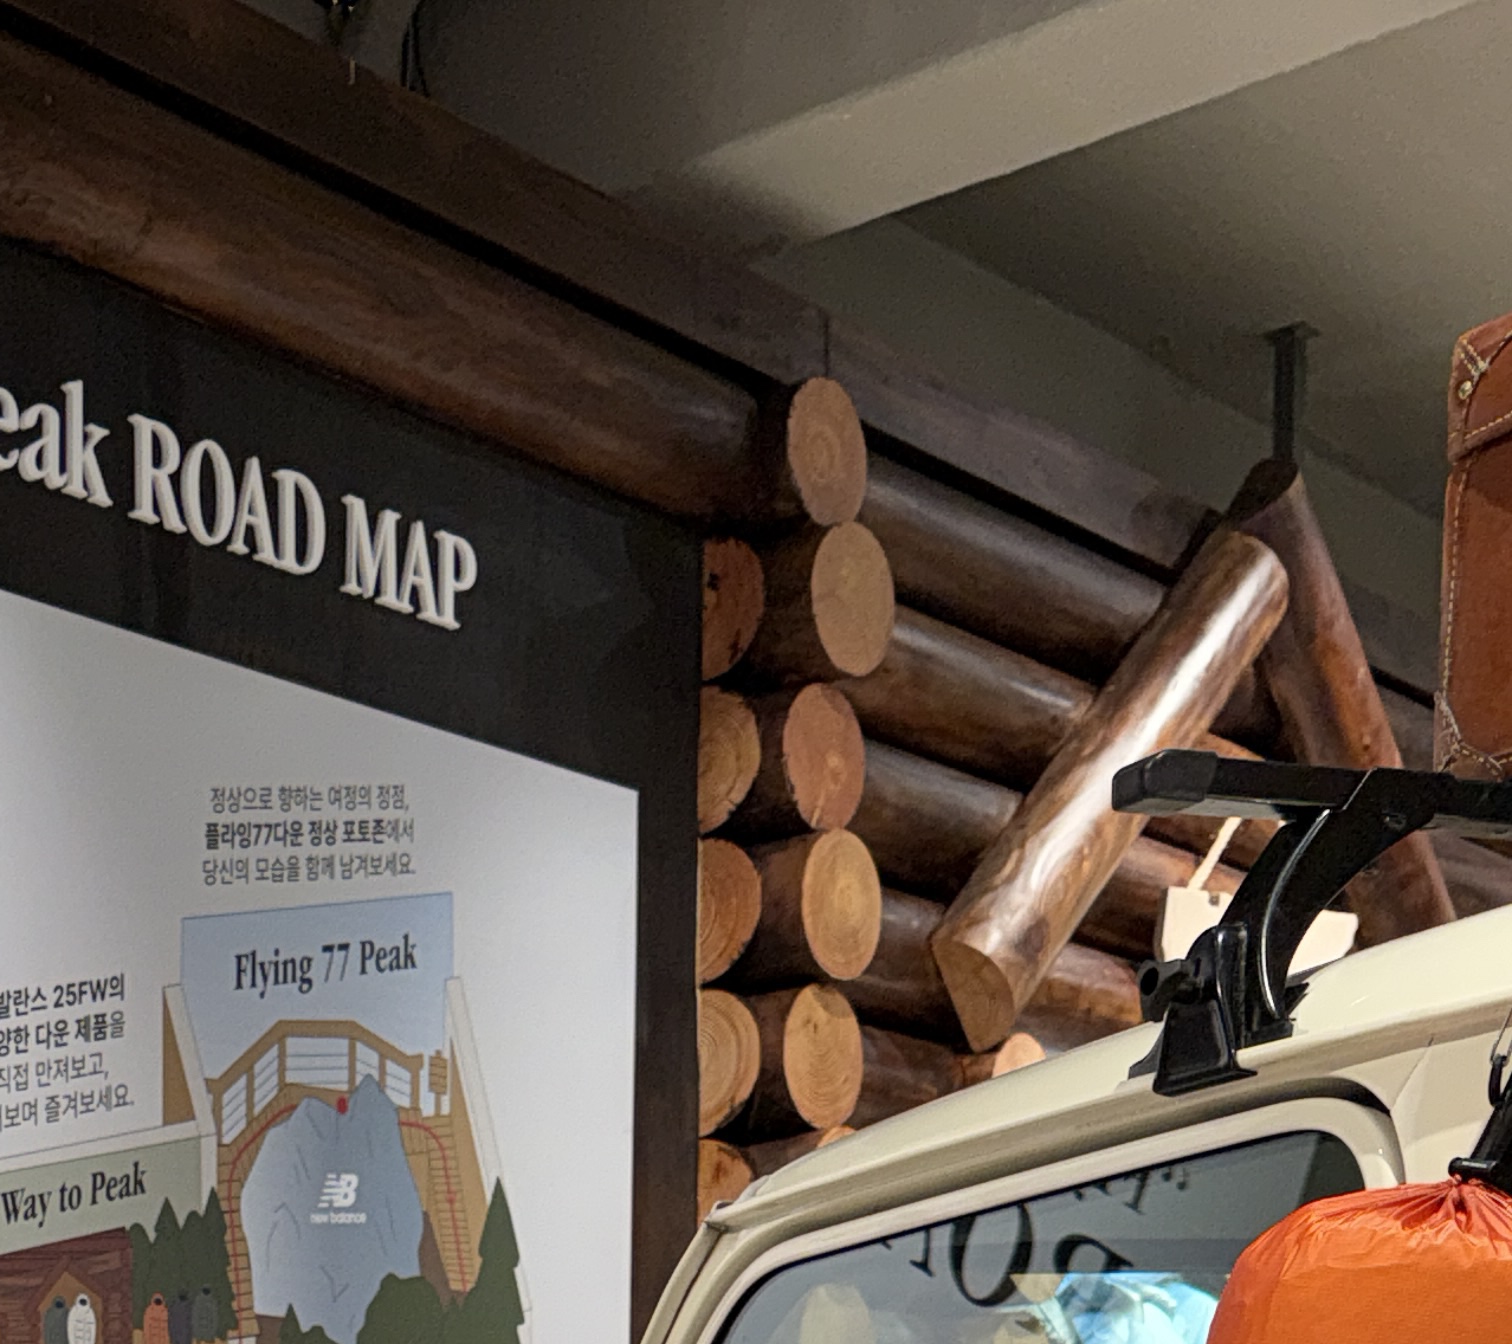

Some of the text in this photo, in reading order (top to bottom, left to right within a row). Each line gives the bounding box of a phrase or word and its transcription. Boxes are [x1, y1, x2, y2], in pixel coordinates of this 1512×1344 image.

[127, 412, 328, 577] ROAD
[339, 492, 479, 631] MAP
[210, 786, 273, 814] 정상으로
[278, 785, 324, 813] 향하는
[328, 784, 371, 811] 여정의
[205, 817, 415, 850] 플라잉77다운 정상 포토존에서
[202, 852, 416, 886] 당신의 모습을 함께 남겨보세요.
[234, 931, 418, 1000] Flying 77 Peak
[53, 972, 125, 1010] 25FW의
[35, 1019, 70, 1050] 다운
[74, 1010, 126, 1043] 제품을
[35, 1051, 110, 1088] 만져보고,
[44, 1083, 135, 1124] 즐겨보세요.
[0, 1160, 147, 1228] Way to Peak
